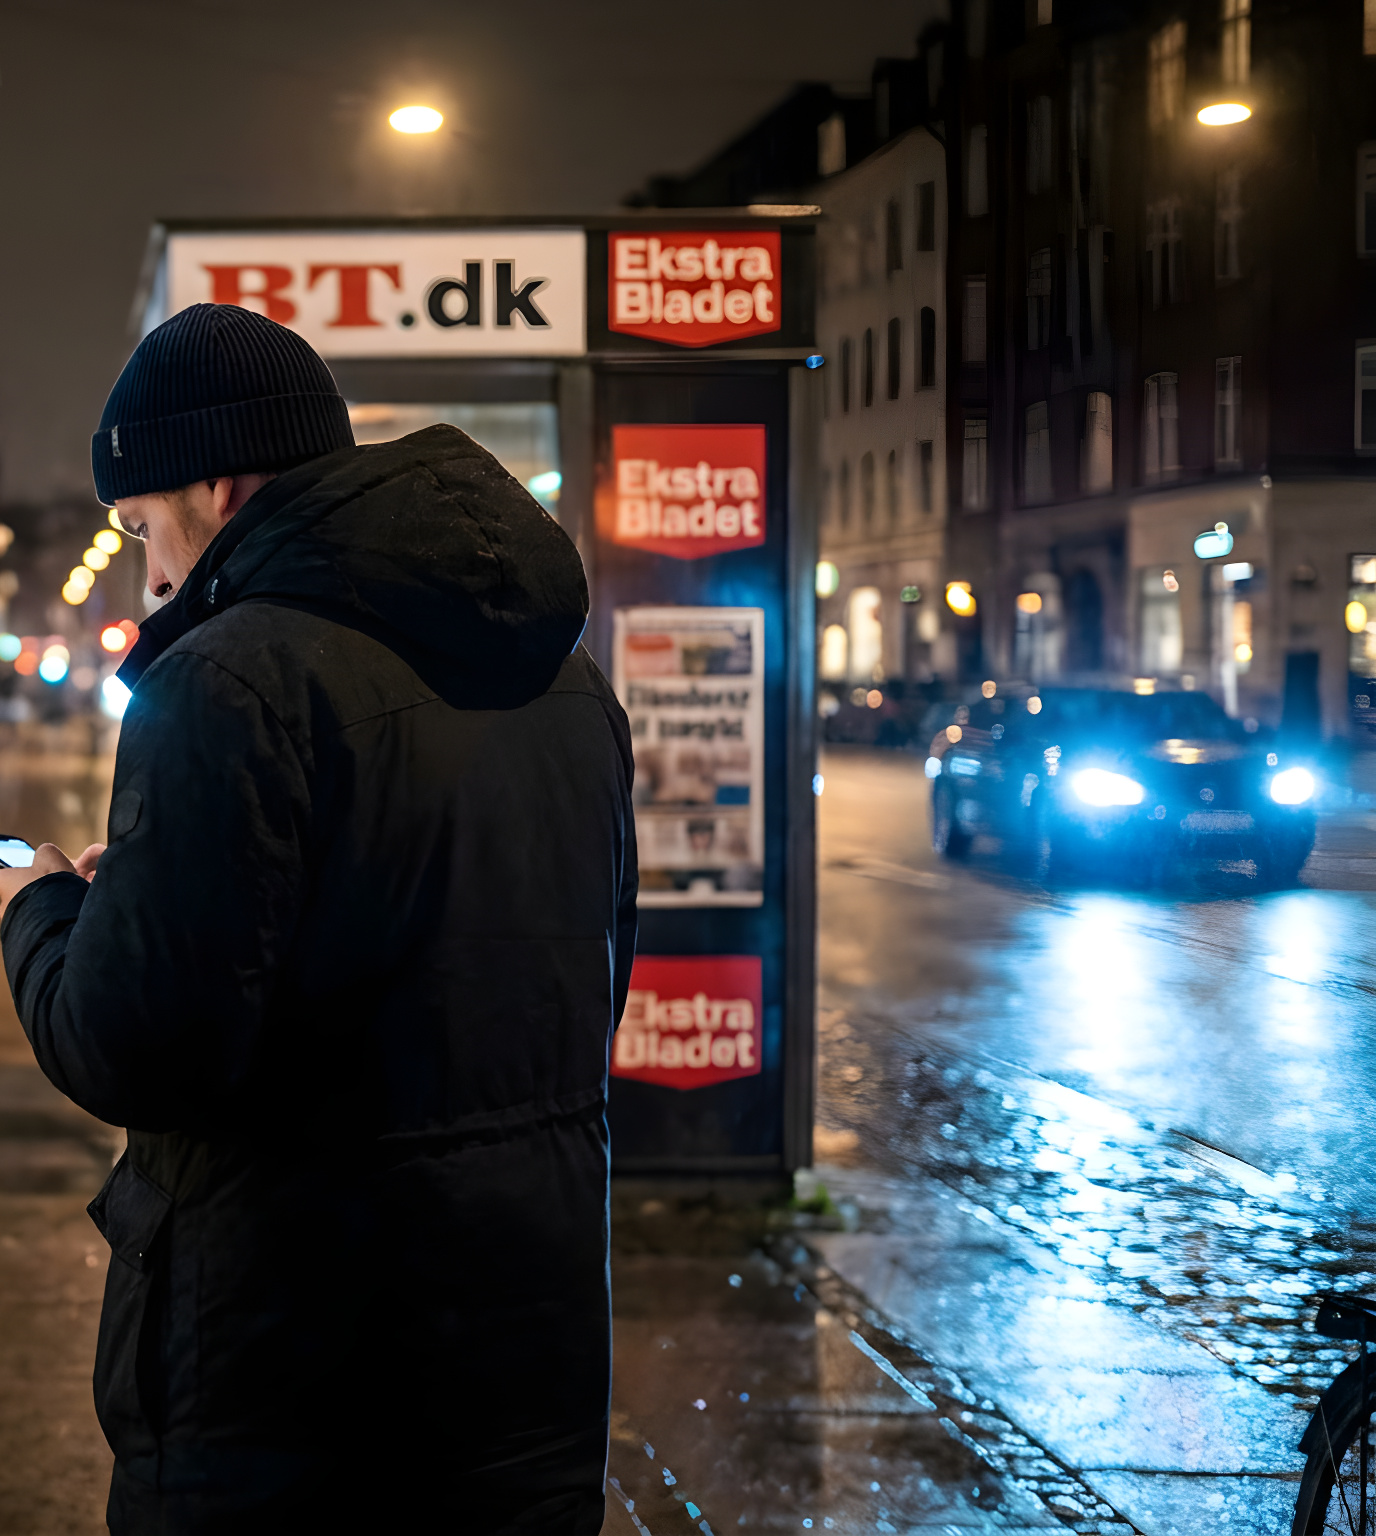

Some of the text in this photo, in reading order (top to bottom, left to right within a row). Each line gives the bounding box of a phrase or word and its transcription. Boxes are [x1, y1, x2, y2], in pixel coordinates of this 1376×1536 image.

[615, 237, 773, 281] Ekstra
[200, 259, 551, 329] BT.dk
[616, 281, 773, 324] Bladet
[617, 459, 760, 500] Ekstra
[618, 499, 761, 538] Bladet
